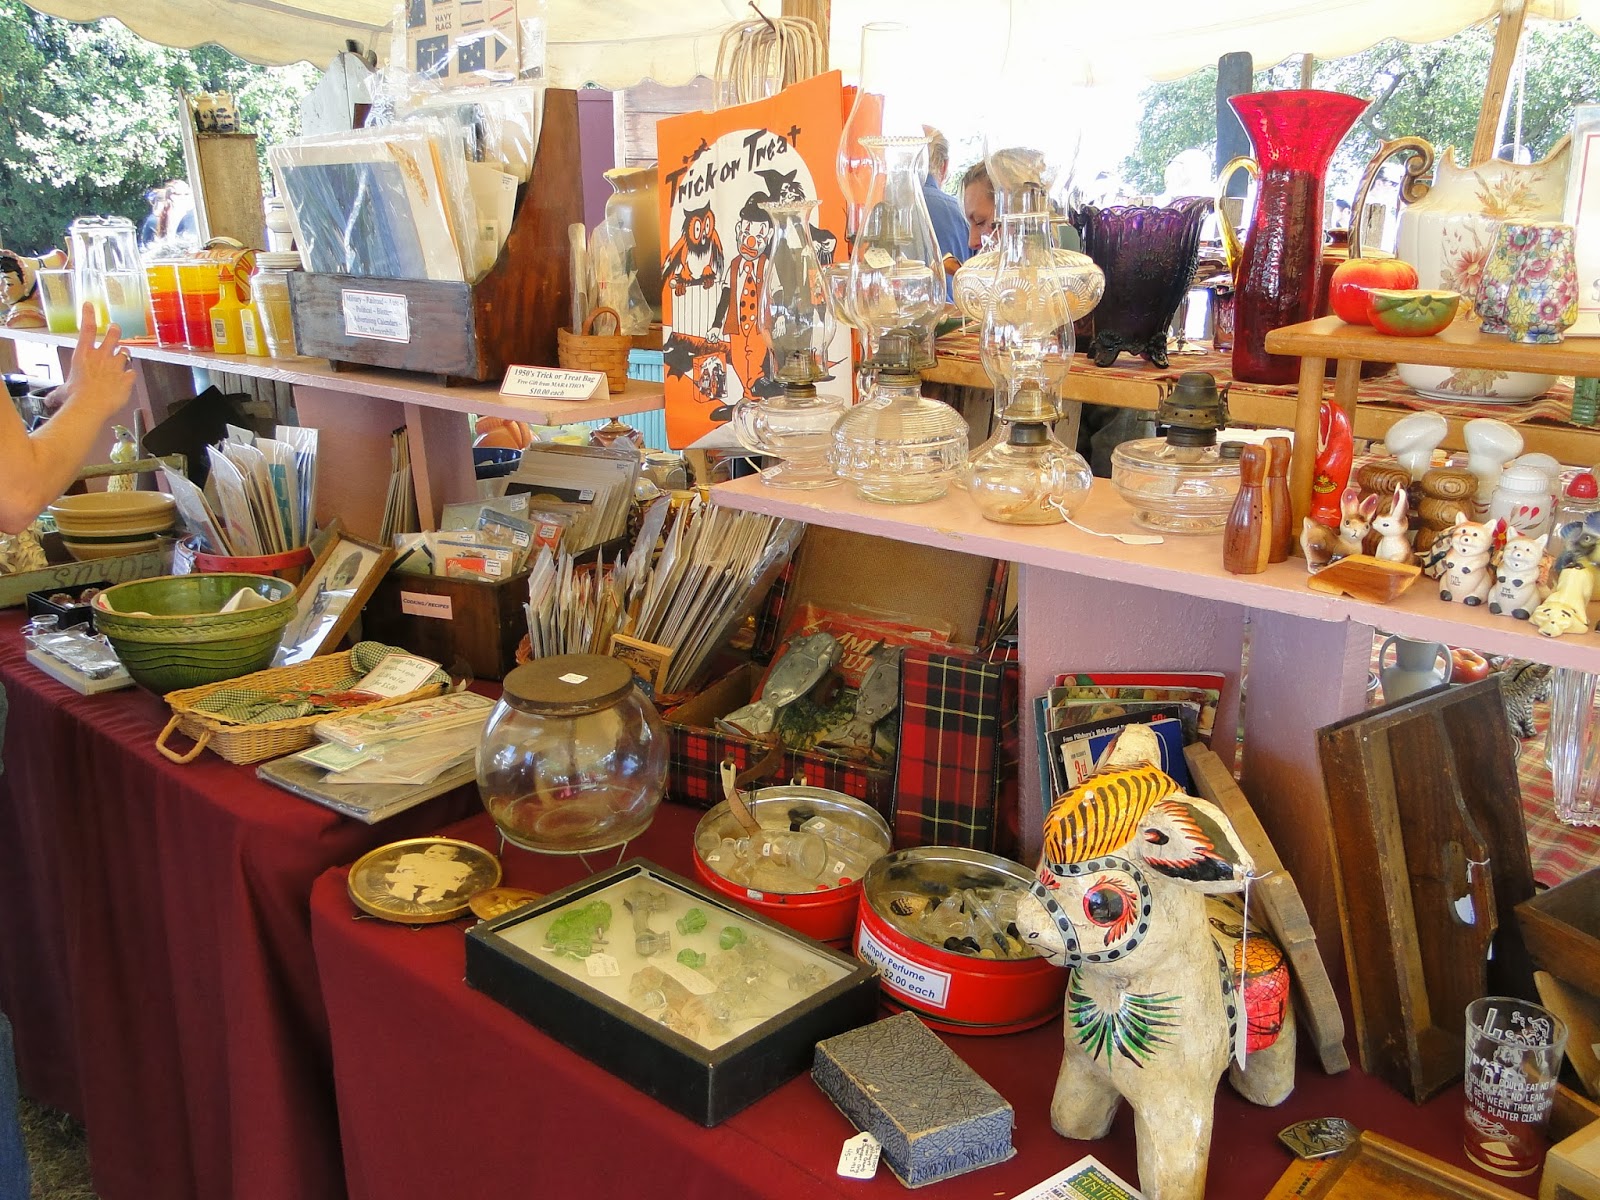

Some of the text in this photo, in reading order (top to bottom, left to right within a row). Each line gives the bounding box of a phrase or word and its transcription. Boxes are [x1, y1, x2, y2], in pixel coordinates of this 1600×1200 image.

[435, 13, 452, 23] NAVY
[436, 22, 452, 31] FLAGS
[665, 125, 801, 208] Trick or Treat
[514, 368, 534, 377] 1950's
[536, 371, 552, 379] Trick
[582, 375, 595, 383] Bag
[529, 388, 550, 396] $10.00
[867, 940, 925, 982] Empty Perfume
[884, 968, 907, 987] $2.00
[908, 982, 935, 998] each
[1500, 1078, 1526, 1092] COULD
[1526, 1082, 1539, 1092] EAT
[1540, 1080, 1550, 1090] NO
[1473, 1089, 1510, 1110] BETWEEN
[1514, 1102, 1534, 1112] THEM
[1511, 1090, 1522, 1101] NO
[1474, 1099, 1485, 1111] THE
[1487, 1106, 1519, 1122] PLATTER
[1051, 1188, 1065, 1199] MAY
